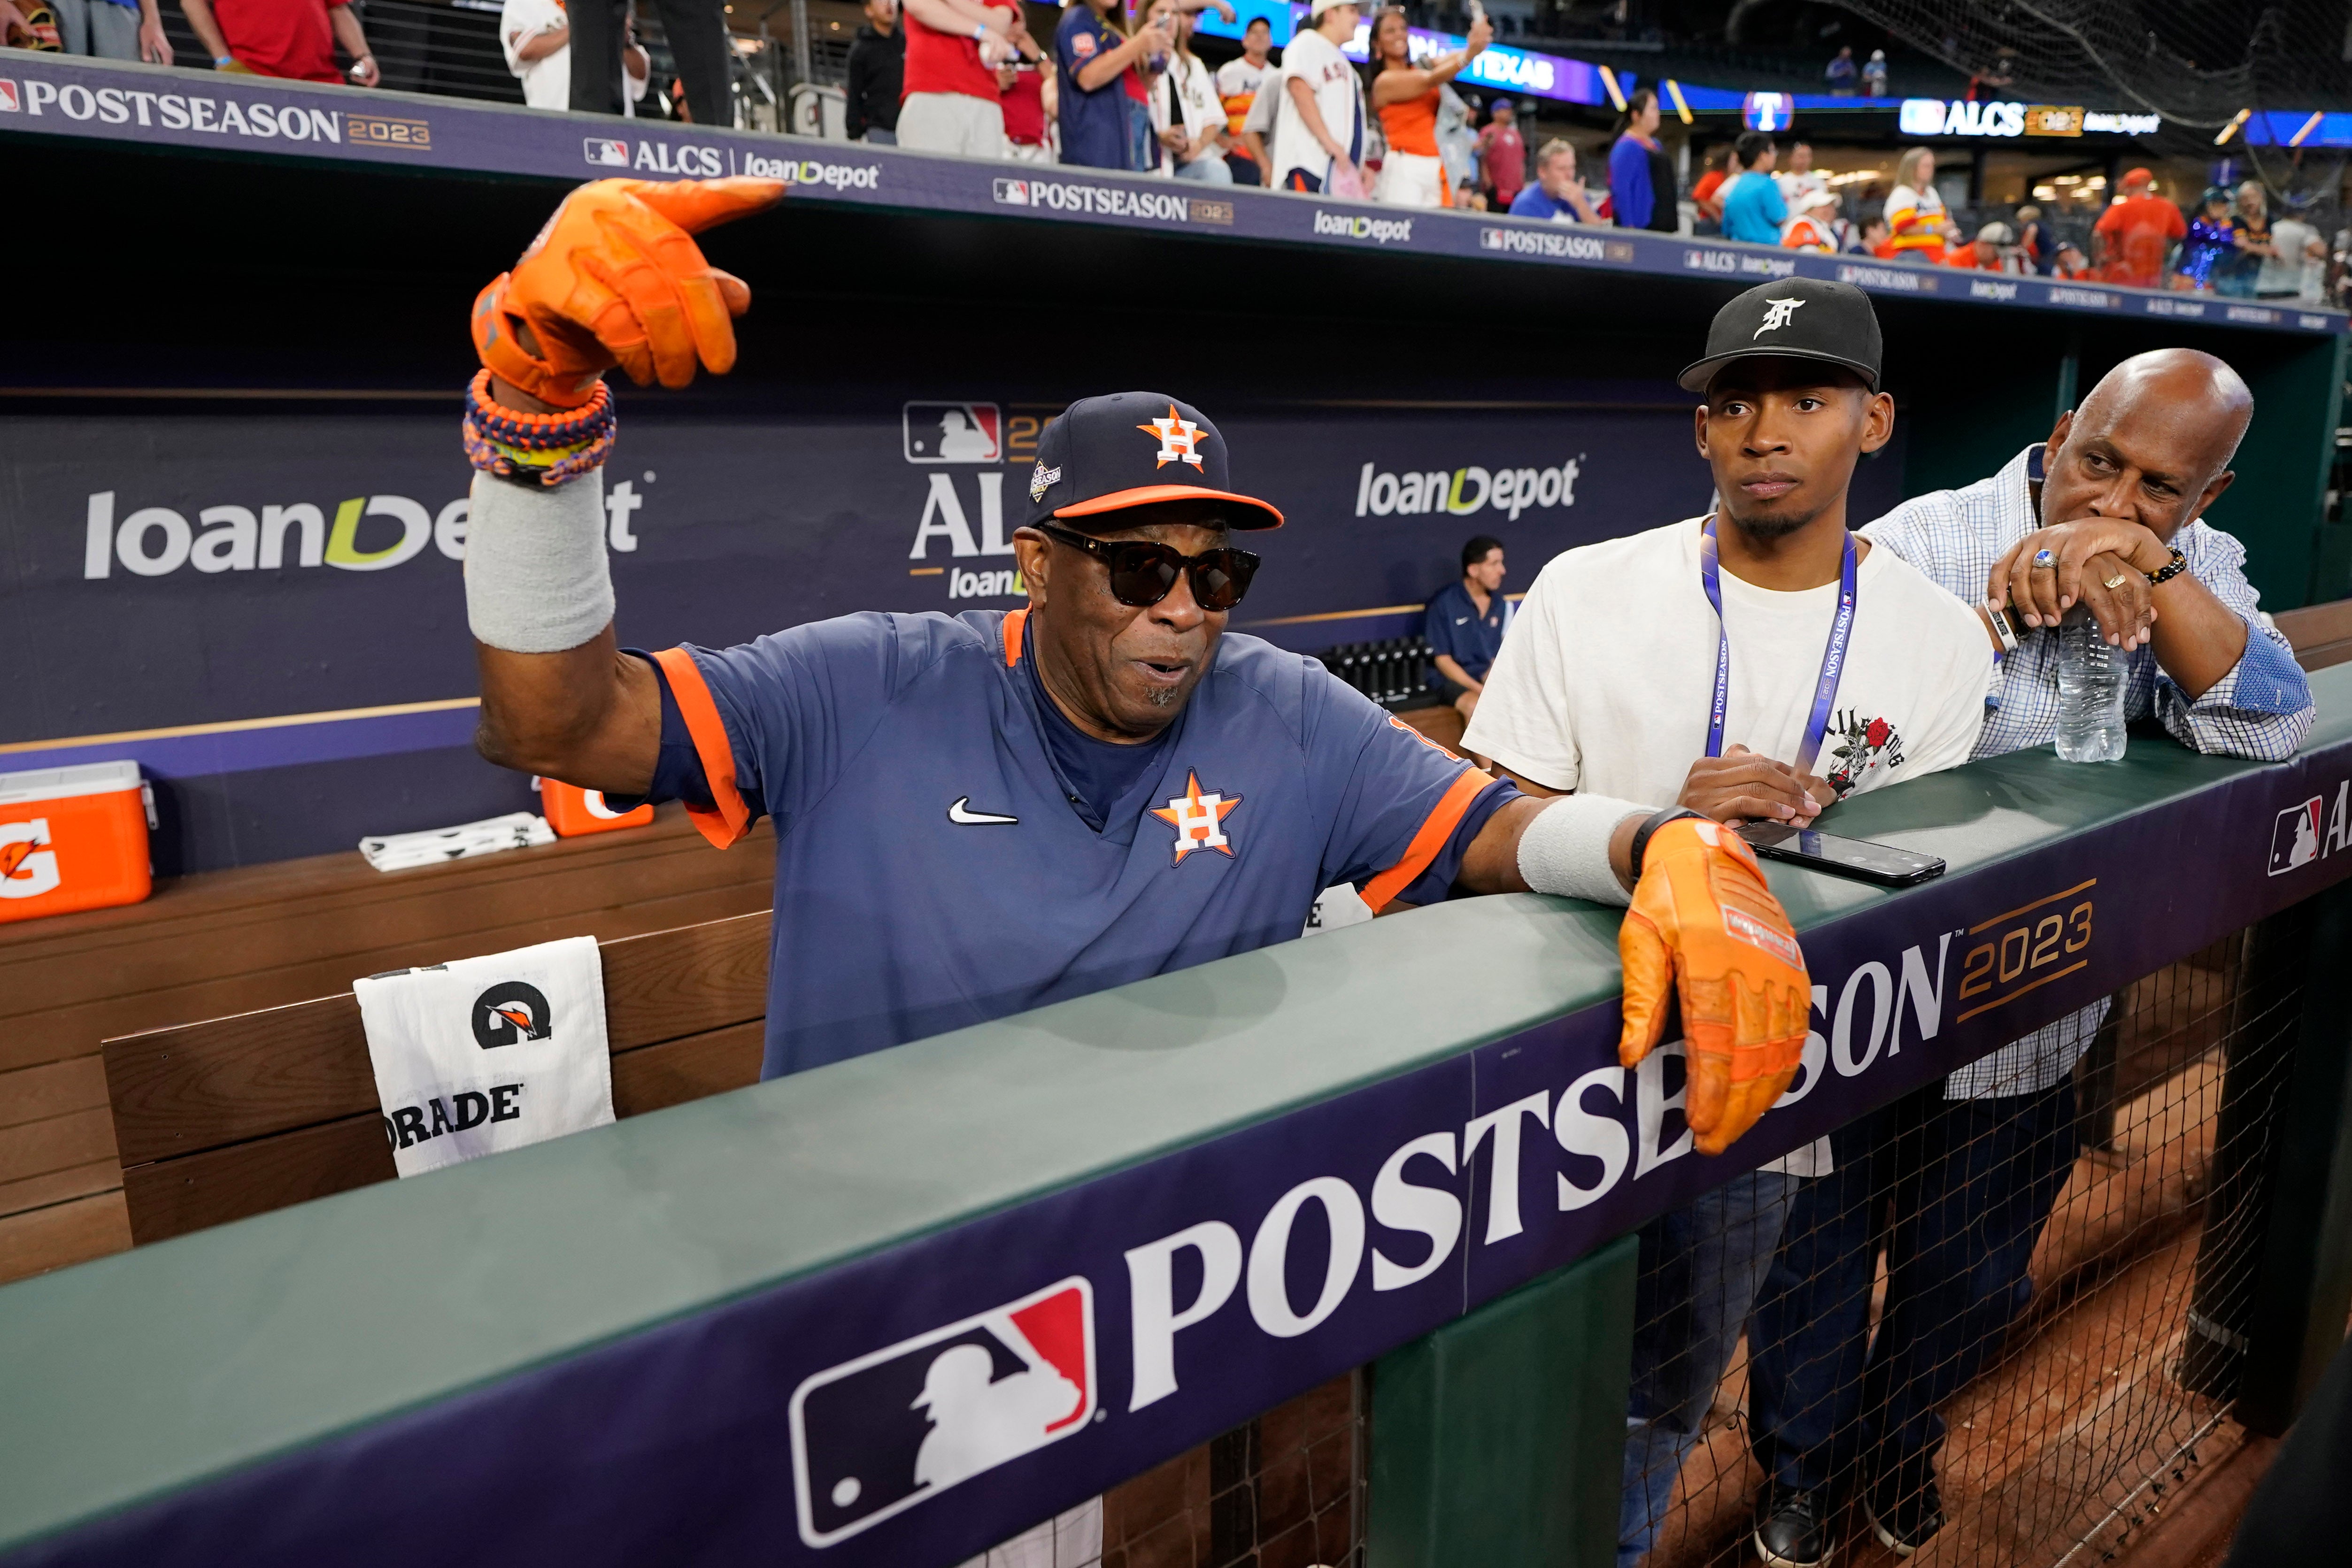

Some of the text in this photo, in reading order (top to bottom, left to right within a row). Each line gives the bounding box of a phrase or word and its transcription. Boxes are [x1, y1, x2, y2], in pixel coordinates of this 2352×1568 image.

[23, 80, 430, 144] POSTSEASON 2023
[1943, 100, 2025, 137] ALCS
[634, 141, 879, 192] ALCS loanDepot
[1031, 181, 1187, 222] POSTSEASON
[1315, 210, 1411, 244] loanDepot
[1504, 229, 1604, 261] POSTSEASON
[1153, 418, 1203, 464] H
[1355, 458, 1580, 522] loanDepot
[1825, 604, 1852, 678] POSTSEASON
[1715, 639, 1727, 714] POSTSEASON
[1169, 793, 1228, 852] H
[1959, 900, 2093, 1000] 2023
